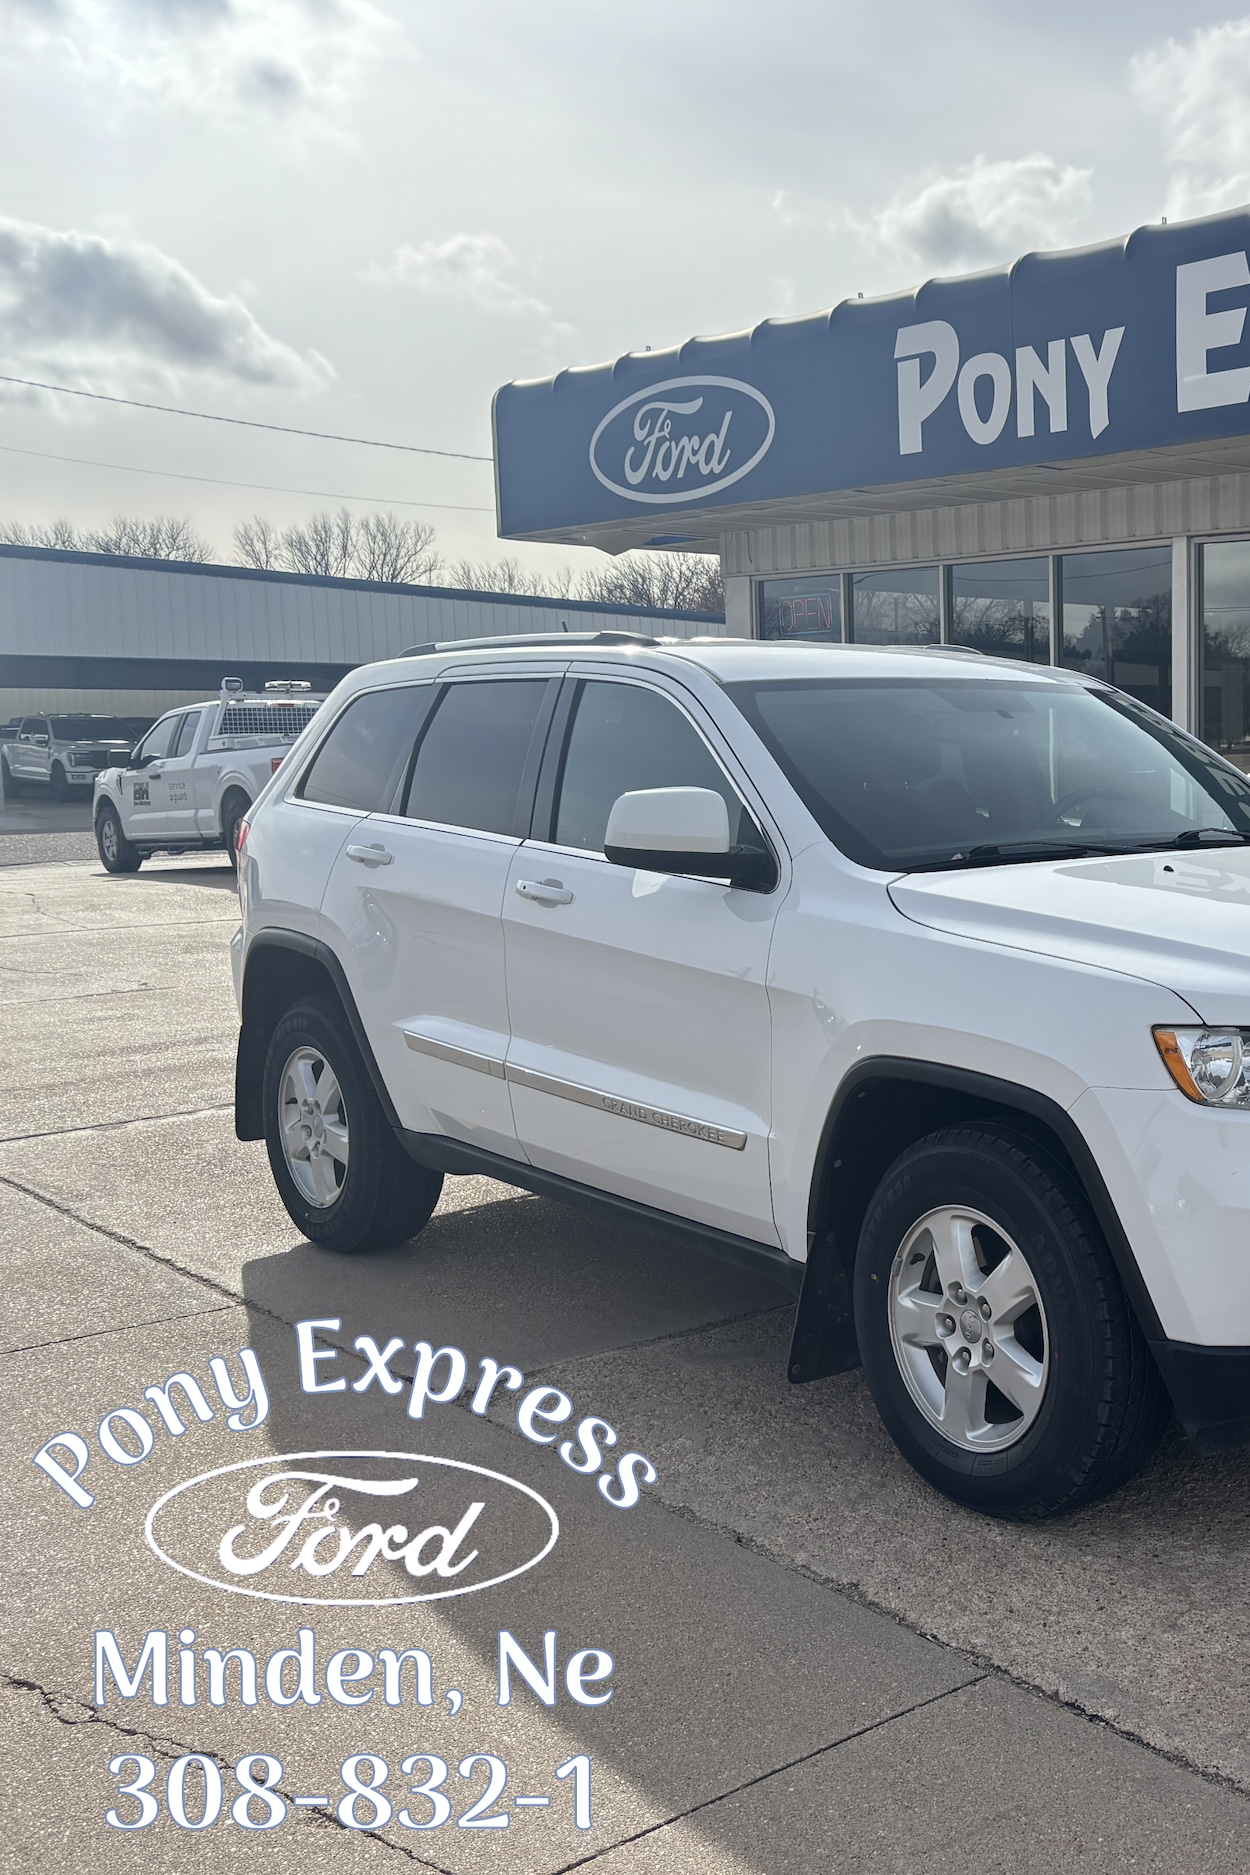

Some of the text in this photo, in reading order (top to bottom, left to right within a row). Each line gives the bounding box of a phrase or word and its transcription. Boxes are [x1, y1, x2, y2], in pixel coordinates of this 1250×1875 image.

[624, 396, 733, 485] Ford
[781, 598, 831, 632] OPEN
[601, 1097, 726, 1143] GRAND CHEROKEE
